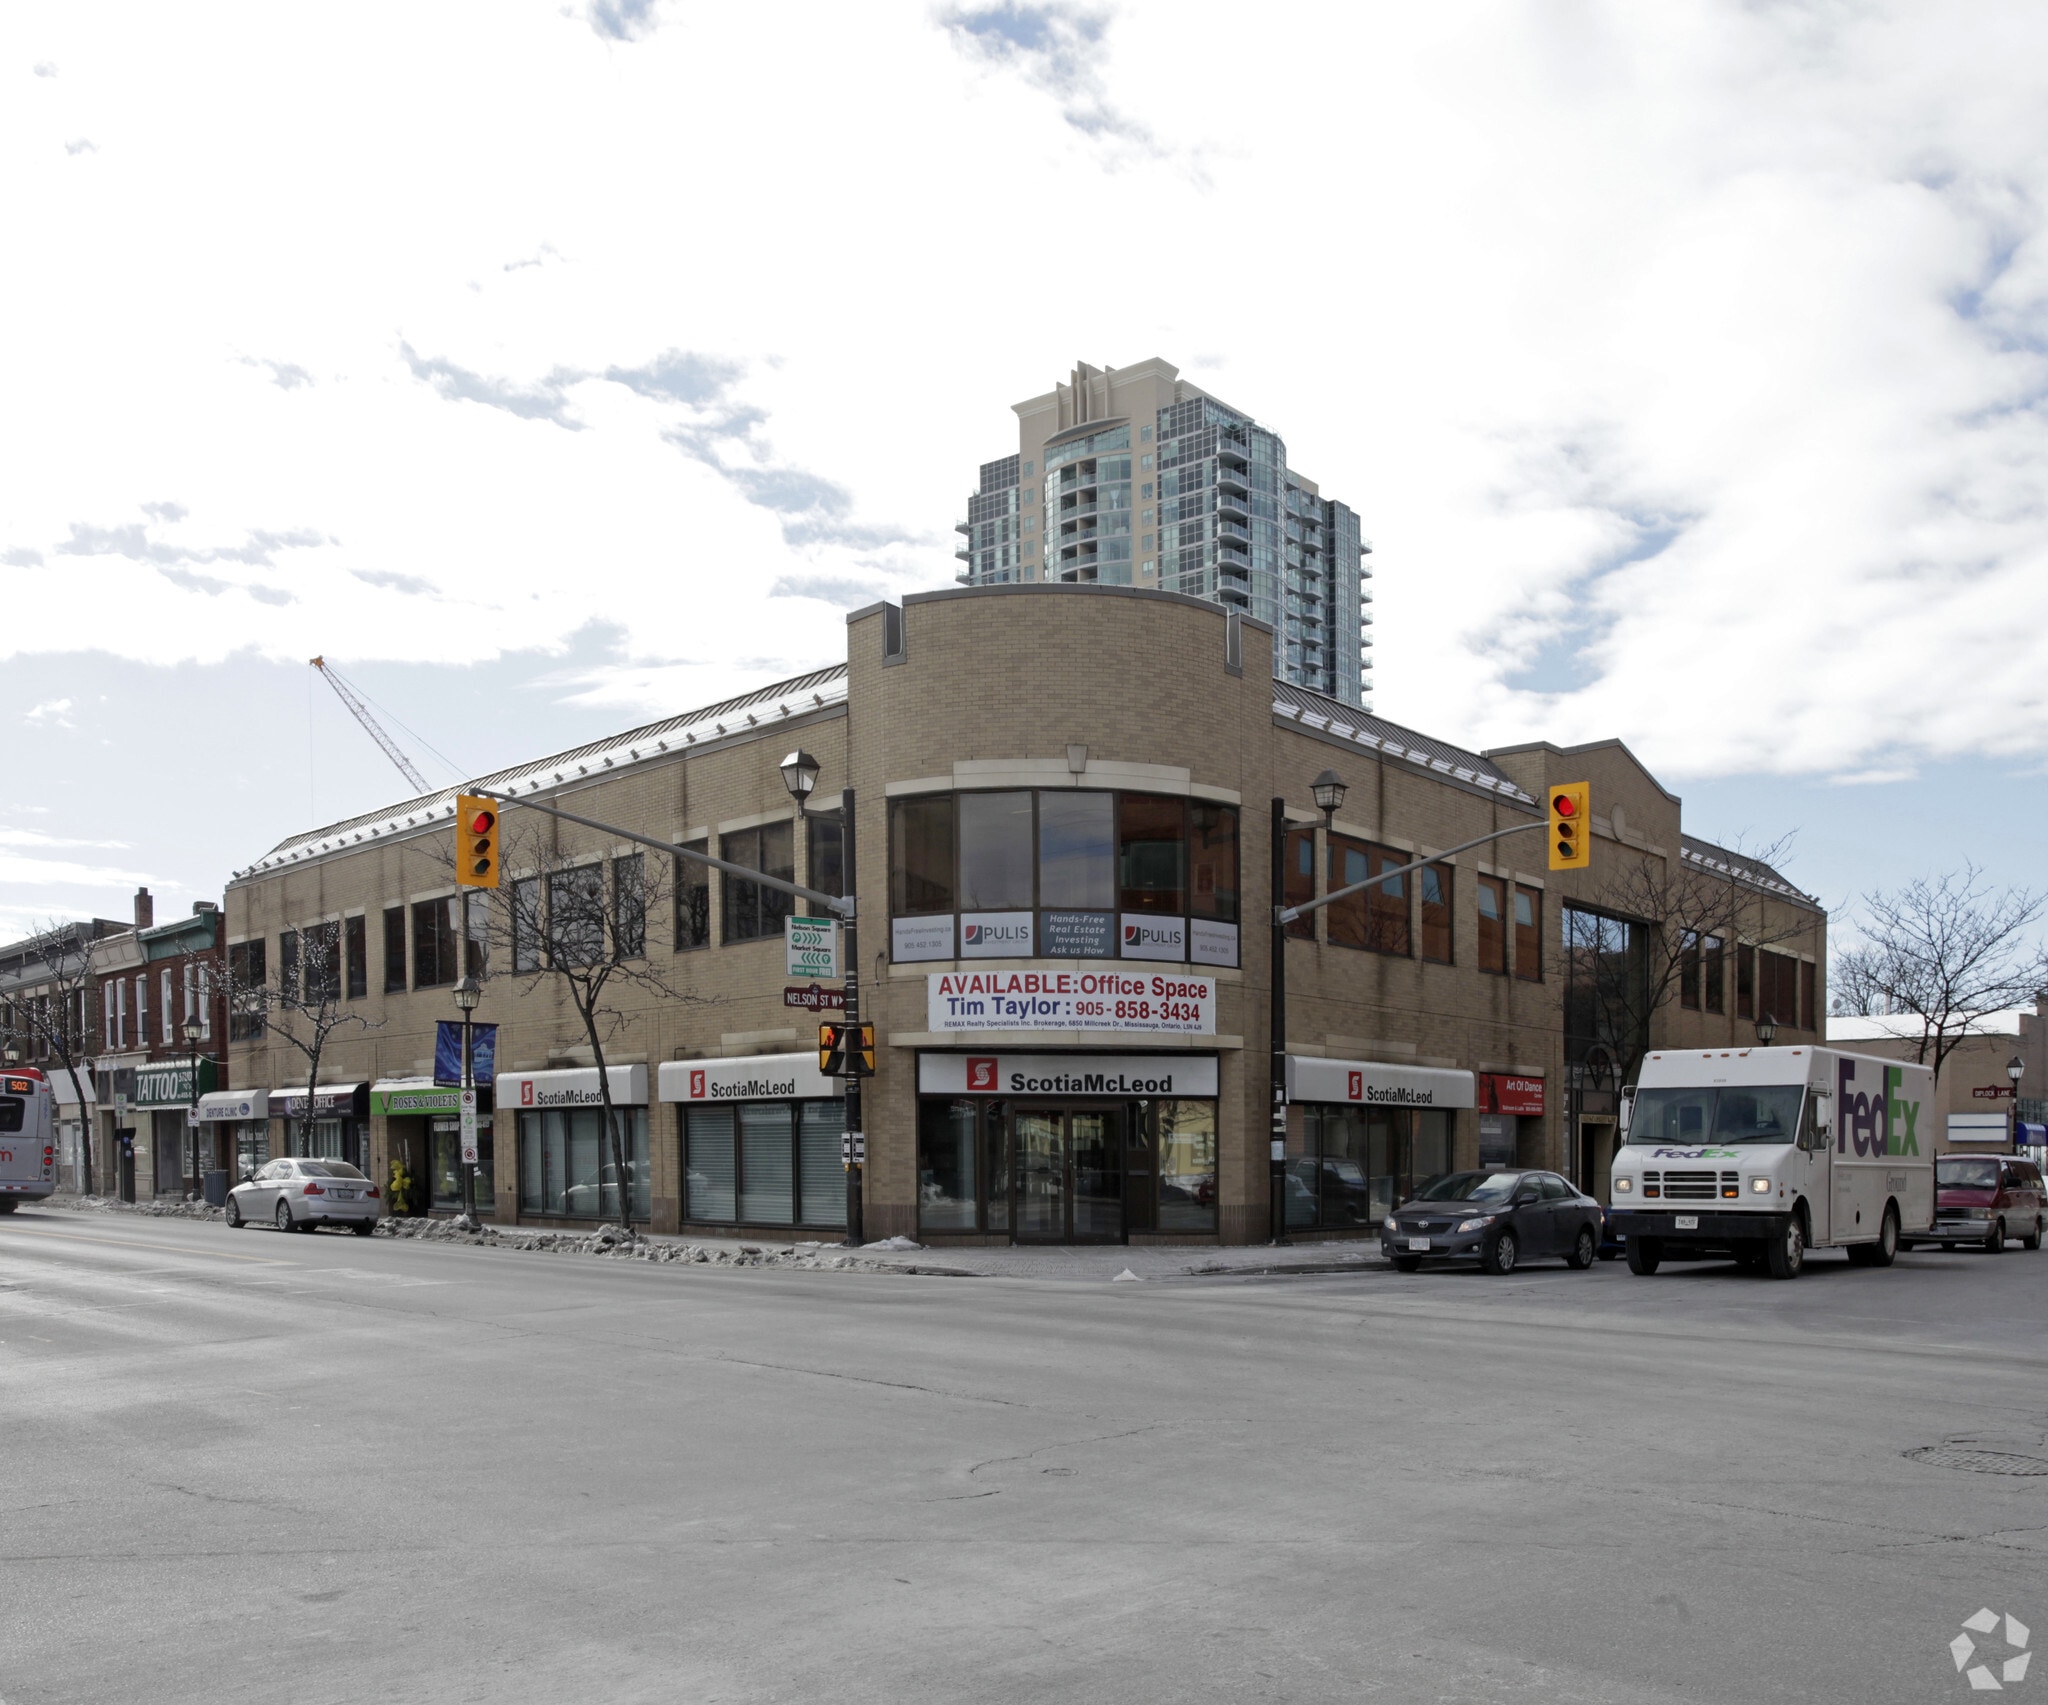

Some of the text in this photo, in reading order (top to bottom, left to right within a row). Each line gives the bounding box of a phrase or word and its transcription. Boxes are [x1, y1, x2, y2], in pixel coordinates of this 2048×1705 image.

[1049, 914, 1105, 924] Hands-Free
[984, 926, 1029, 940] PULIS
[1049, 925, 1106, 935] Real Estate
[1142, 929, 1182, 944] PULIS
[1055, 935, 1100, 946] Investing
[1050, 946, 1068, 954] Ask
[1083, 946, 1105, 955] How
[819, 967, 832, 976] FREE
[1151, 976, 1208, 1001] Space
[786, 992, 838, 1007] NELSON ST W
[947, 997, 985, 1016] Tim
[944, 1020, 966, 1028] REMAX
[966, 1020, 985, 1028] Realty
[986, 1019, 1020, 1027] Specialists
[1020, 1019, 1032, 1027] Inc.
[11, 1081, 28, 1092] 502
[136, 1072, 179, 1101] TATTOO
[711, 1078, 795, 1098] ScotiaMcLeod
[1010, 1073, 1173, 1093] ScotiaMcLeod
[1506, 1080, 1543, 1093] Art Of Dance
[537, 1089, 602, 1105] ScotiaMcLeod
[1367, 1085, 1433, 1104] ScotiaMcLeod
[1997, 1089, 2011, 1097] LANE
[313, 1095, 335, 1108] OFFICE
[393, 1094, 458, 1110] ROSES & VIOLETS
[1838, 1057, 1921, 1159] FedEx
[224, 1106, 238, 1118] CLINIC
[449, 1121, 460, 1131] SHOP
[1651, 1148, 1742, 1159] FedEx
